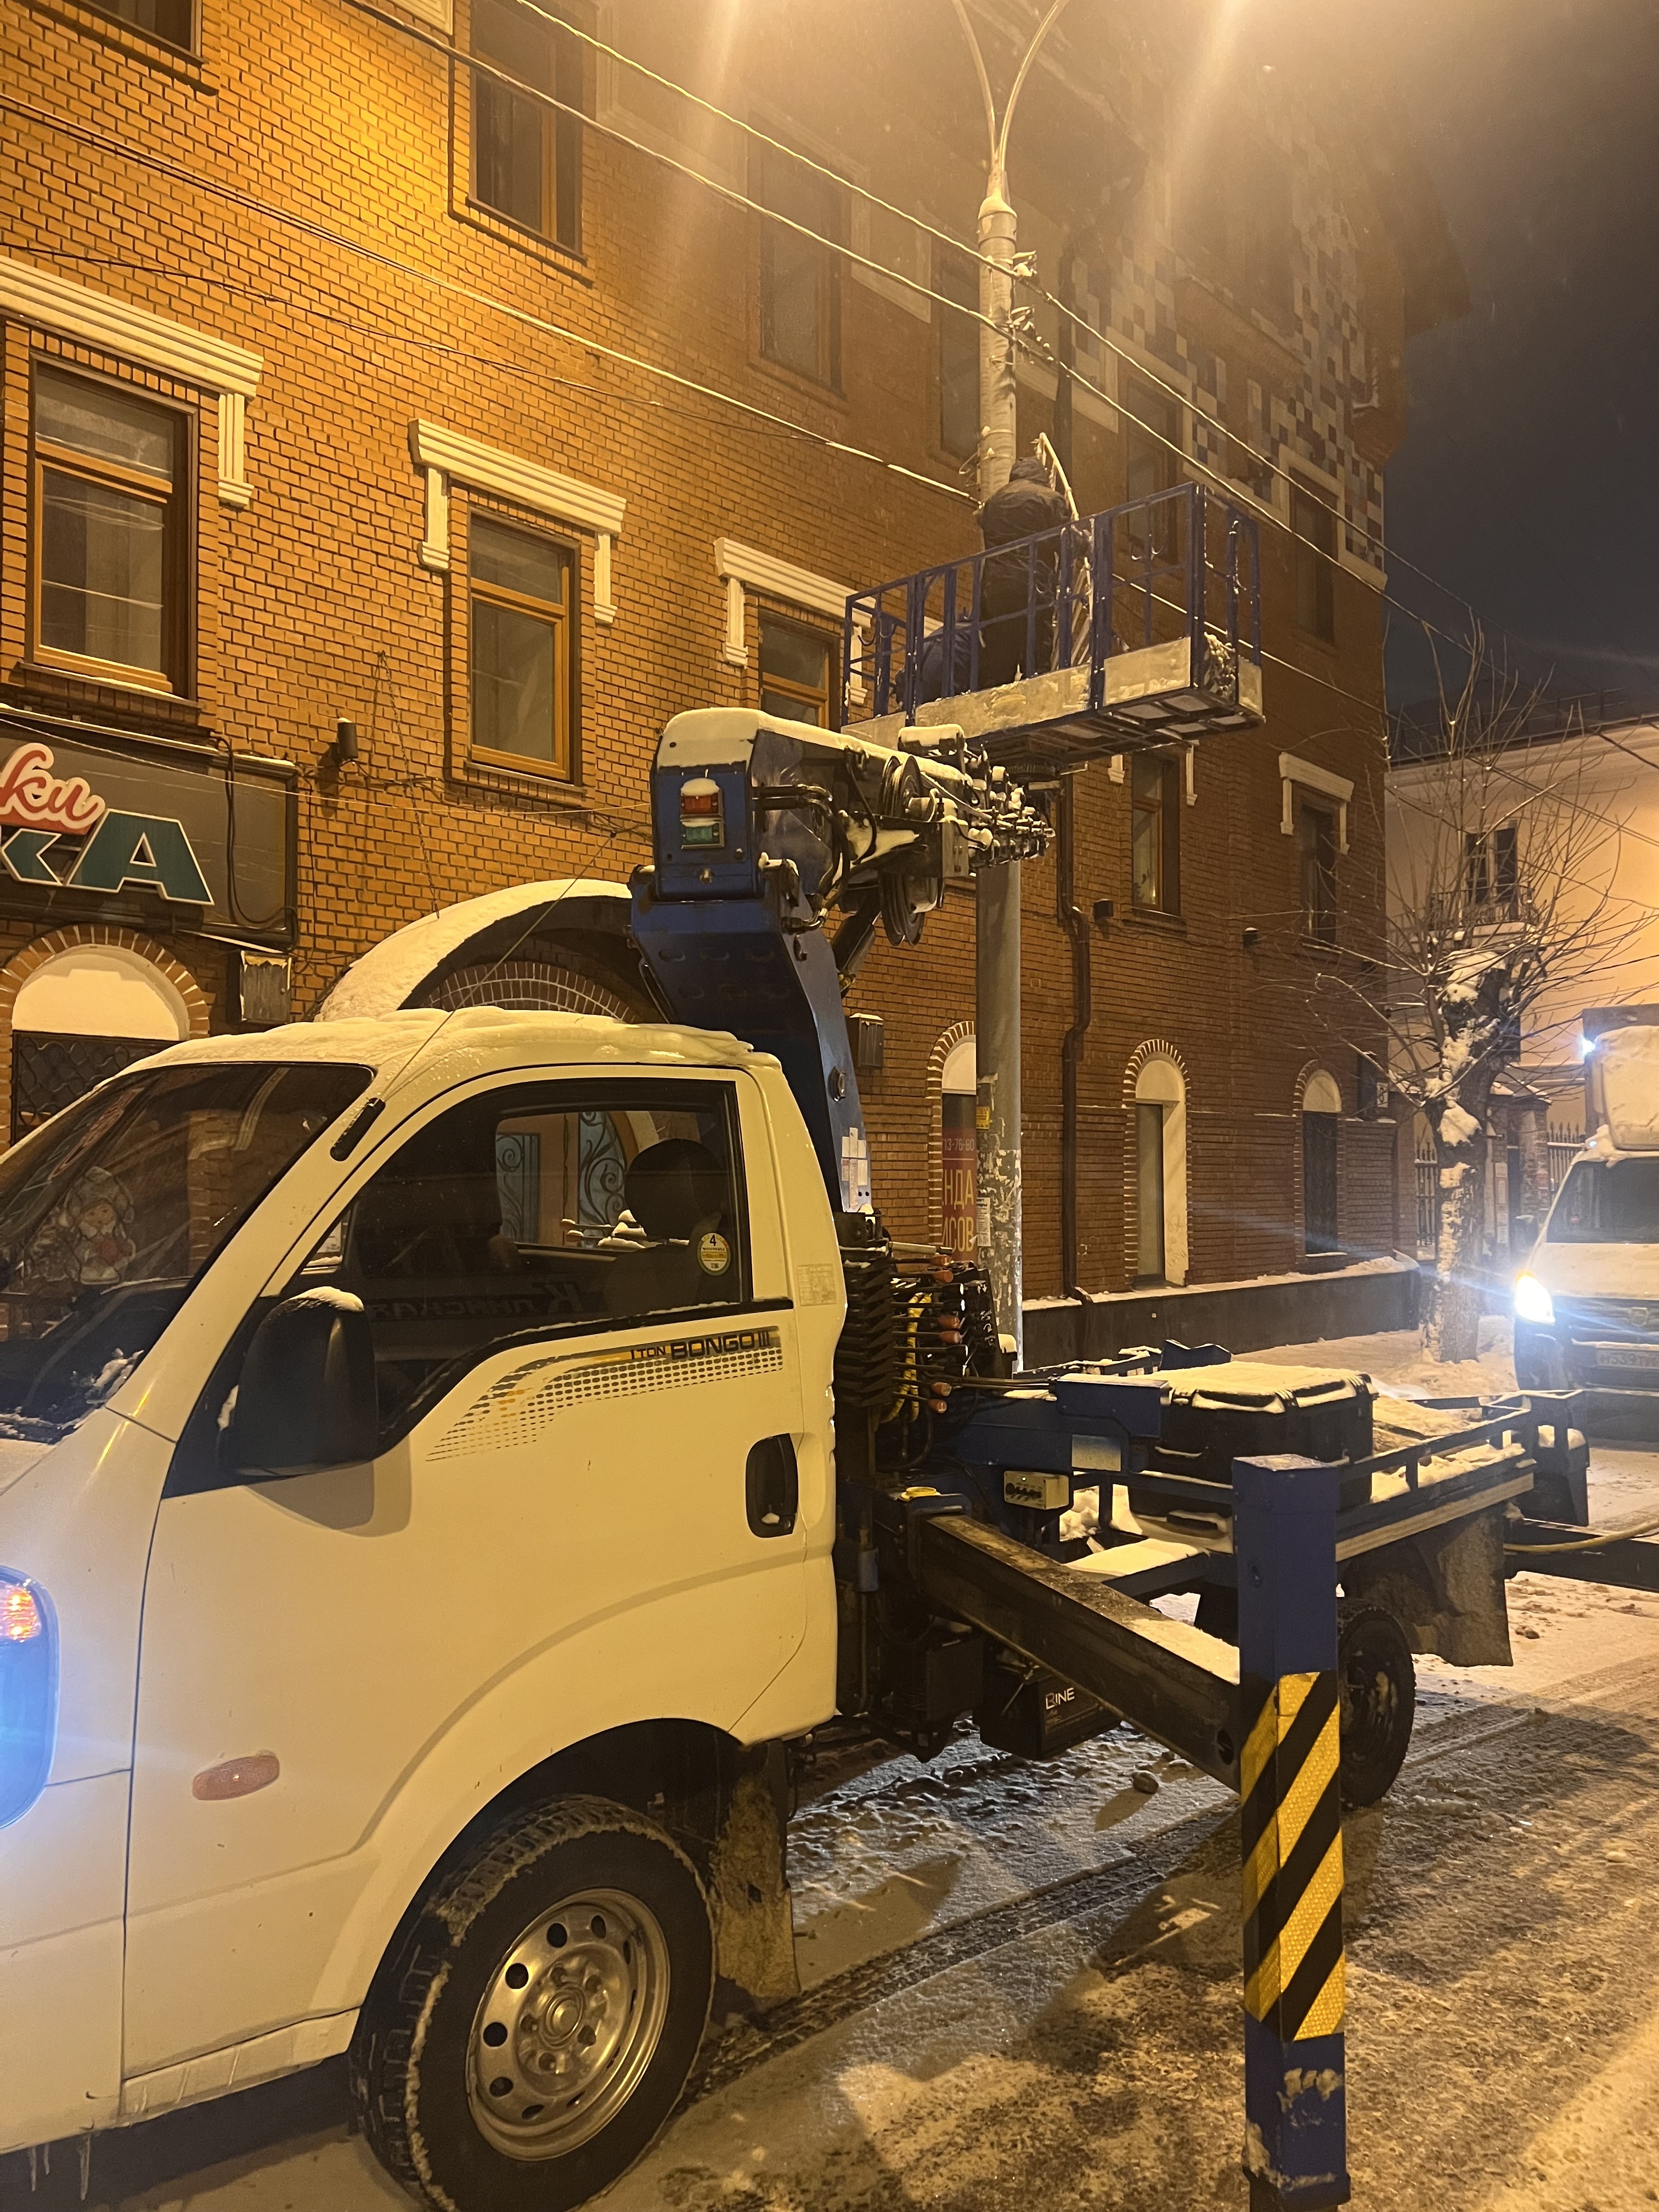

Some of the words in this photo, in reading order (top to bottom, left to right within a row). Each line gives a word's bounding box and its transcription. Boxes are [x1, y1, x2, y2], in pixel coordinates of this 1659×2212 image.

[943, 1138, 974, 1151] 13-76-80
[943, 1169, 974, 1210] НДА
[709, 1234, 716, 1246] 4
[670, 1332, 755, 1359] BONGO
